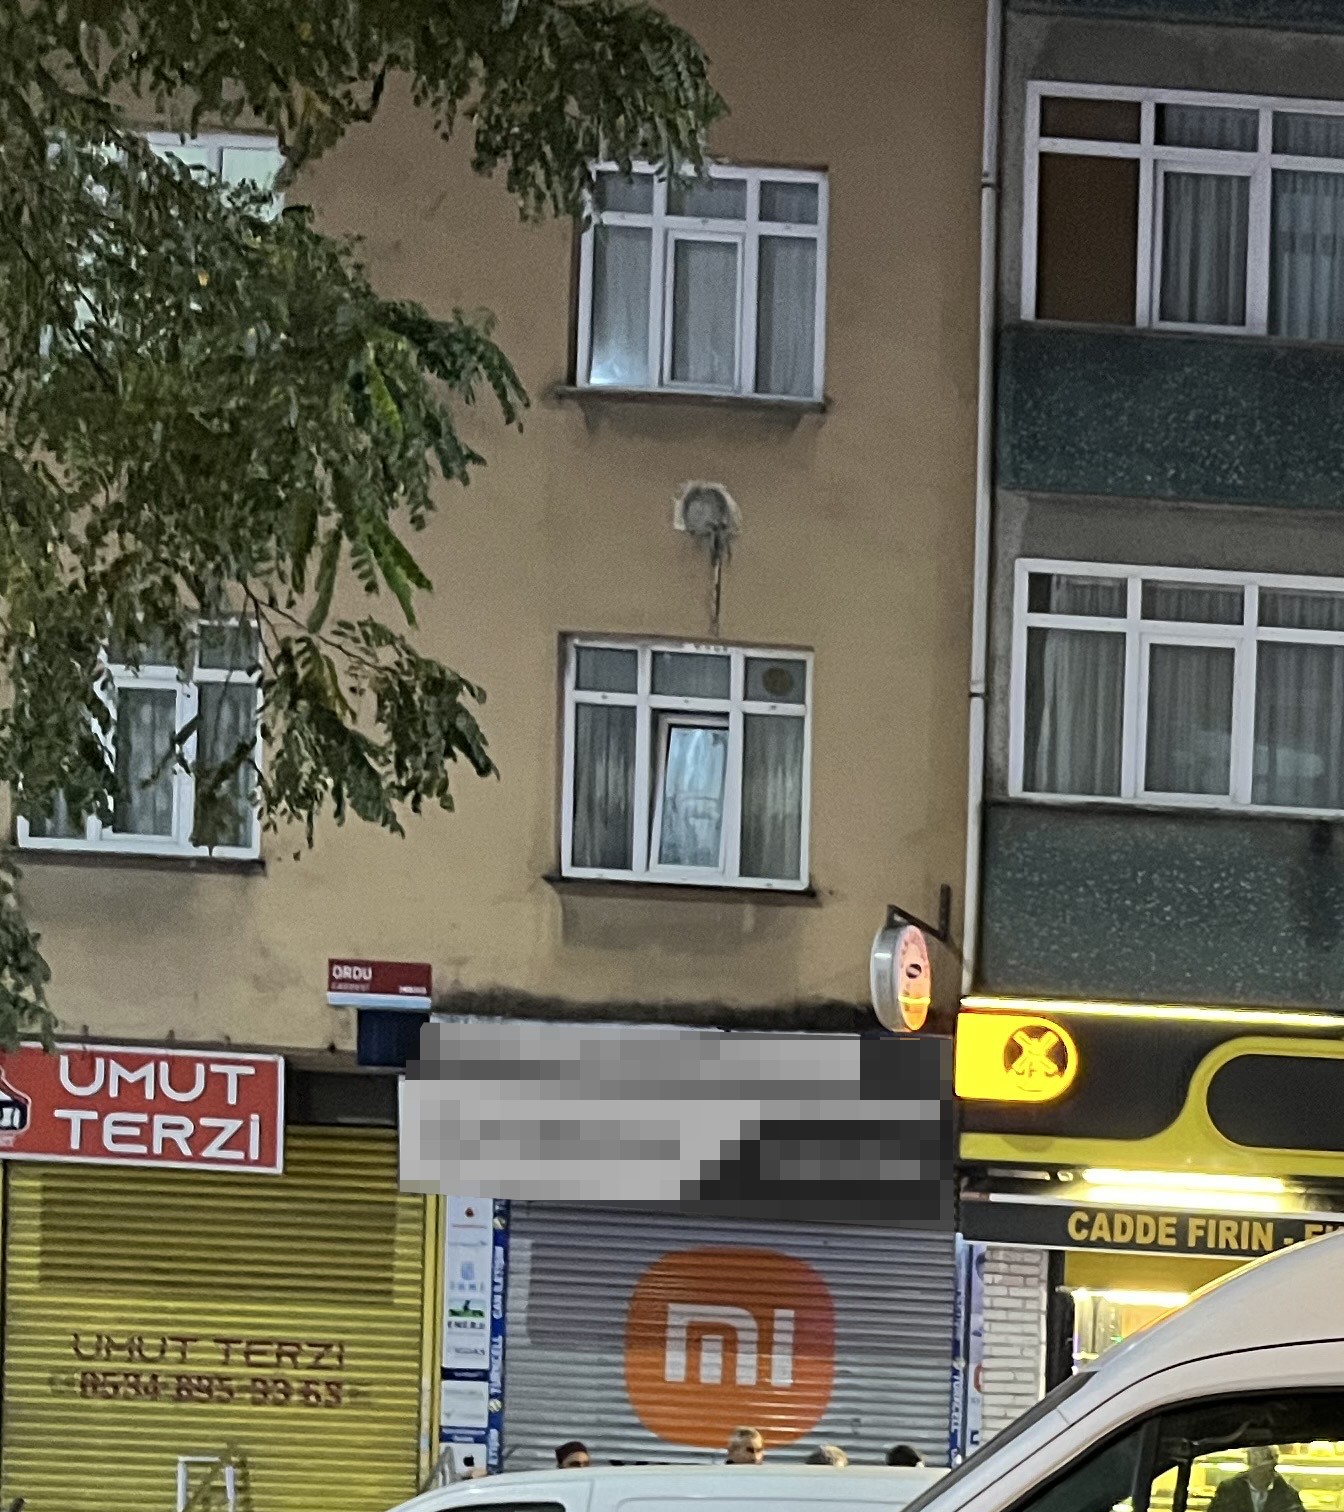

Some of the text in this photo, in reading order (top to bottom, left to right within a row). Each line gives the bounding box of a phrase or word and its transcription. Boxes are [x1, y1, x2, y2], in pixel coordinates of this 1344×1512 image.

[332, 964, 373, 980] ORDU
[59, 1054, 256, 1106] UMUT
[53, 1109, 261, 1161] TERZİ
[1067, 1210, 1178, 1246] CADDE
[1187, 1217, 1275, 1251] FIRIN
[71, 1332, 200, 1364] UMUT
